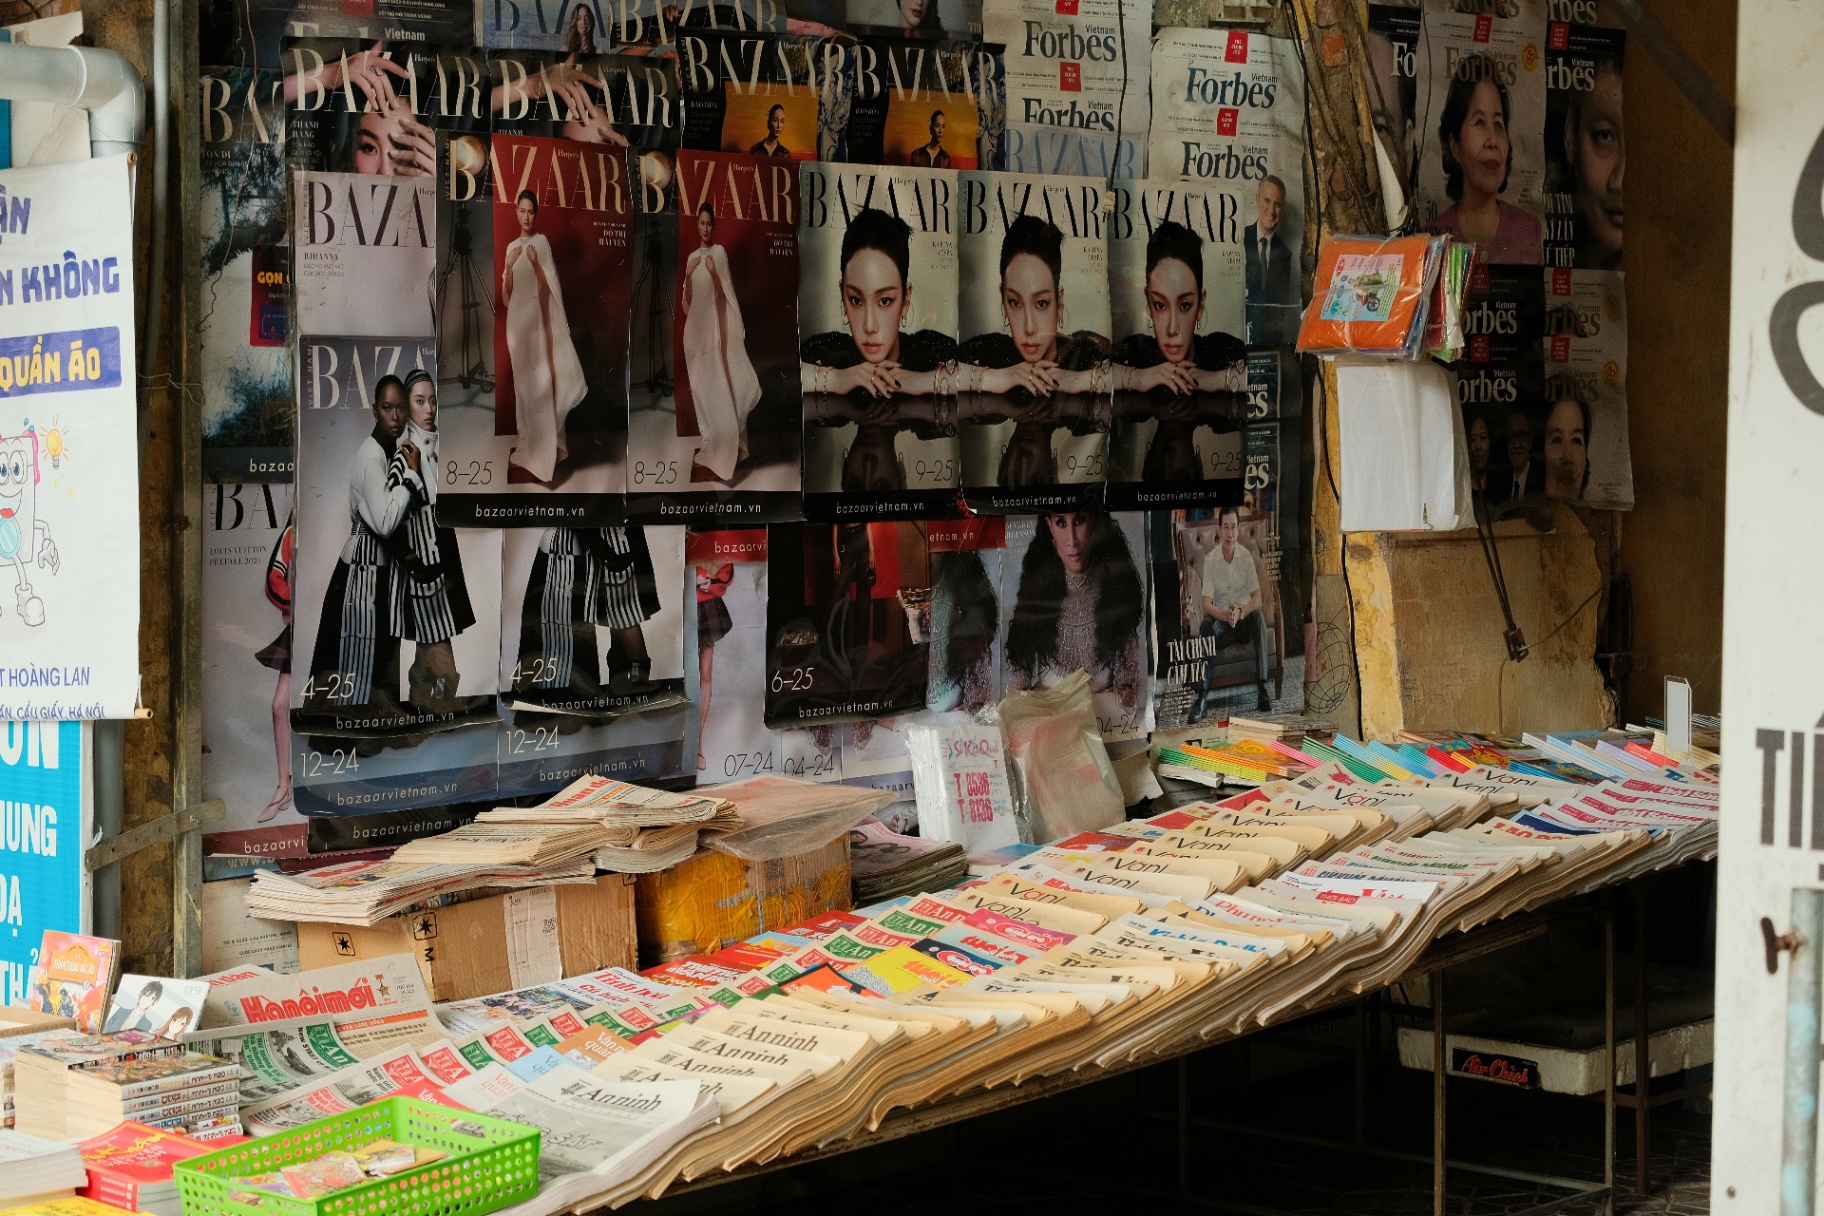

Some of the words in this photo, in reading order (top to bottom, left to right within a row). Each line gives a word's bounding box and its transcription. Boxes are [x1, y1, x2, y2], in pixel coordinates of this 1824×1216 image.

[385, 27, 426, 41] Vietnam
[1022, 20, 1117, 62] Forbes
[1086, 25, 1116, 34] Vietnam
[685, 35, 847, 101] BAZAAR
[1445, 46, 1518, 87] Forbes
[1494, 51, 1518, 62] Vietnam
[1571, 57, 1595, 68] Vietnam
[857, 44, 997, 109] BAZAAR
[1184, 67, 1277, 109] Forbes
[1251, 72, 1278, 83] Vietnam
[1022, 98, 1115, 132] Forbes
[1087, 101, 1114, 111] Vietnam
[557, 149, 580, 160] Harper's
[1180, 141, 1268, 181] Forbes
[1241, 145, 1269, 155] Vietnam
[449, 139, 626, 214] BAZAAR
[640, 149, 796, 225] BAZAAR
[807, 171, 953, 235] BAZAAR
[966, 180, 1102, 241] BAZAAR
[1112, 187, 1241, 245] BAZAAR
[22, 250, 120, 303] KHÔNG
[257, 271, 283, 286] GỌN
[1495, 301, 1517, 310] Vietnam
[1493, 370, 1517, 379] Vietnam
[445, 460, 493, 485] 8-25
[633, 460, 678, 485] 8-25
[915, 460, 954, 482] 9-25
[1066, 454, 1103, 477] 9-25
[1210, 451, 1243, 473] 9-25
[1244, 462, 1269, 490] es
[660, 502, 762, 515] bazaarvietnam.vn
[836, 502, 925, 515] bazaarvietnam.vn
[992, 495, 1077, 508] bazaarvietnam.vn
[1136, 491, 1218, 503] bazaarvietnam.vn
[475, 503, 585, 518] bazaarvietnam.vn
[210, 546, 232, 556] LOUIS
[9, 662, 60, 687] HOÀNG
[64, 667, 90, 686] LAN
[509, 657, 558, 683] 4-25
[771, 667, 815, 693] 6-25
[300, 674, 356, 700] 4-25
[336, 711, 455, 730] bazaarvietnam.vn
[799, 699, 893, 719] bazaarvietnam.vn
[506, 725, 561, 755] 12-24
[300, 747, 360, 778] 12-24
[540, 758, 646, 782] bazaarvietnam.vn
[725, 751, 774, 776] 07-24
[337, 782, 458, 806] bazaarvietnam.vn
[353, 817, 473, 839] bazaarvietnam.vn
[1461, 1054, 1488, 1074] Air
[1489, 1058, 1529, 1084] Chief
[578, 1086, 662, 1111] Anninh
